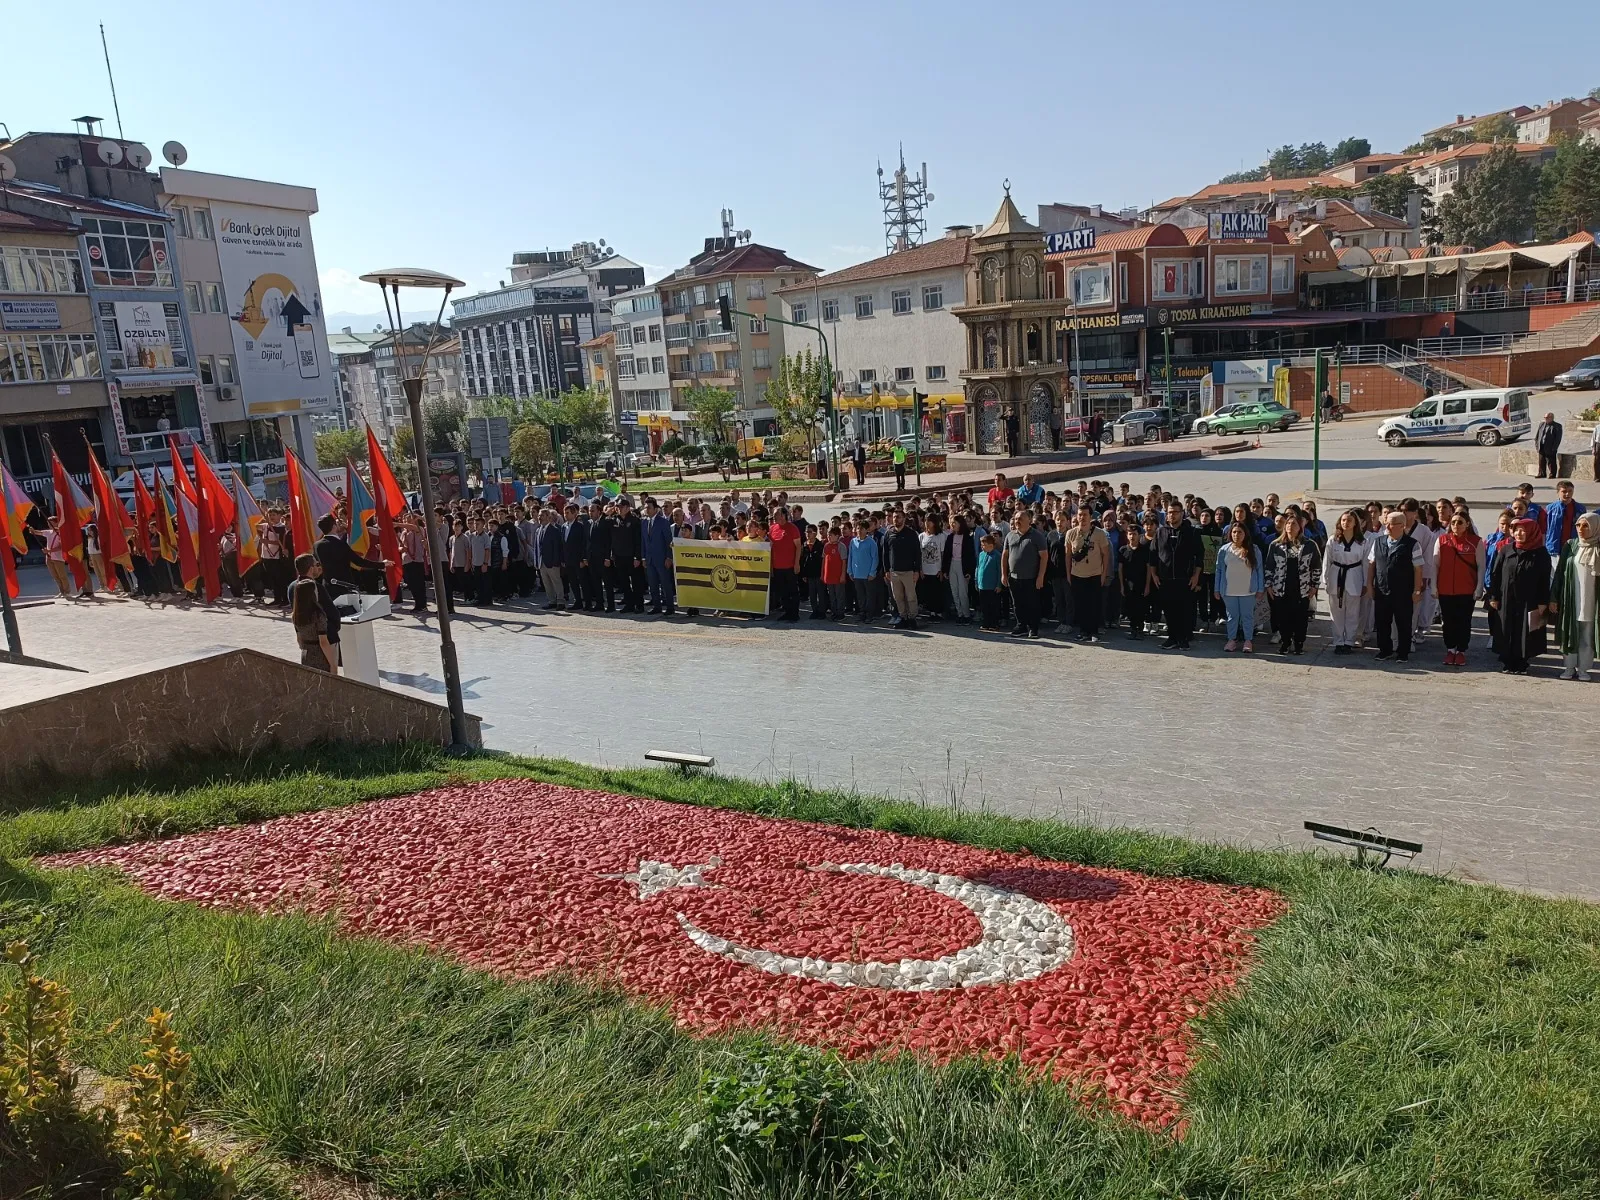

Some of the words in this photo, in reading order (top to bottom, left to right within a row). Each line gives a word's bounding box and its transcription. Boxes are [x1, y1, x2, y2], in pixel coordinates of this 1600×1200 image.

[1223, 213, 1239, 231] AK
[276, 225, 301, 239] Dijital
[221, 236, 242, 244] Güven
[252, 238, 276, 247] esneklik
[277, 239, 286, 248] bir
[286, 240, 303, 248] arada
[1054, 228, 1094, 252] PARTİ
[1170, 308, 1198, 321] TOSYA
[1055, 312, 1120, 331] RAATHANESİ
[124, 328, 166, 338] ÖZBİLEN
[261, 350, 283, 362] Dijital
[1410, 418, 1433, 427] POLİS
[704, 552, 727, 560] İDMAN
